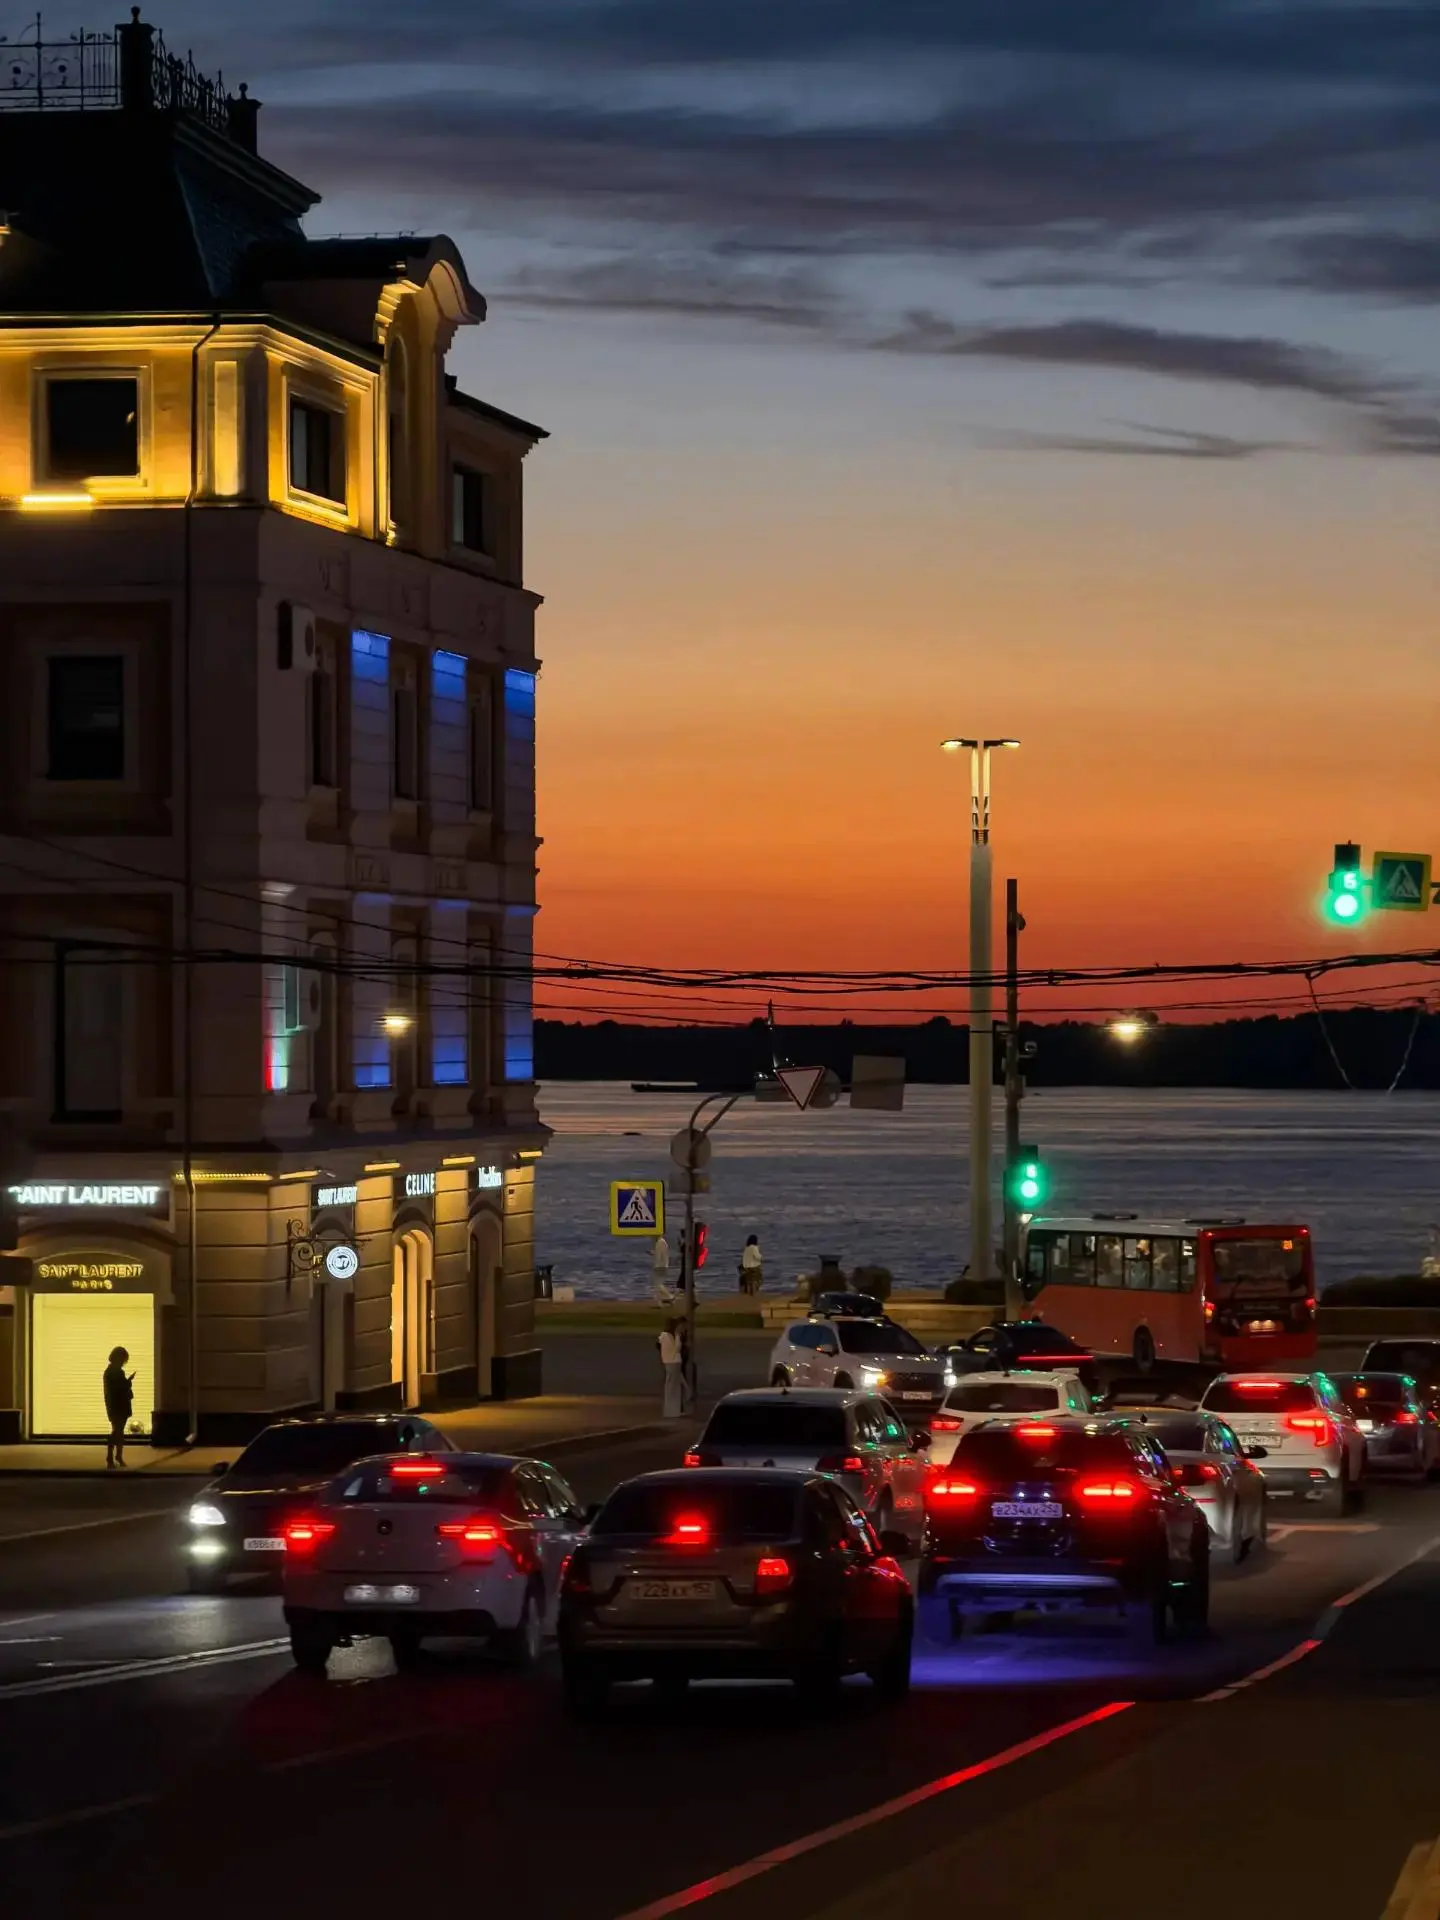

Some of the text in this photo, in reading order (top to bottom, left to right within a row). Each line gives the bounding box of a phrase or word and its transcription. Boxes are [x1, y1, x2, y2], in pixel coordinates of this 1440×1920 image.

[406, 1172, 435, 1196] CELINE
[68, 1185, 161, 1204] LAURENT
[39, 1263, 144, 1278] SAINT LAURENT
